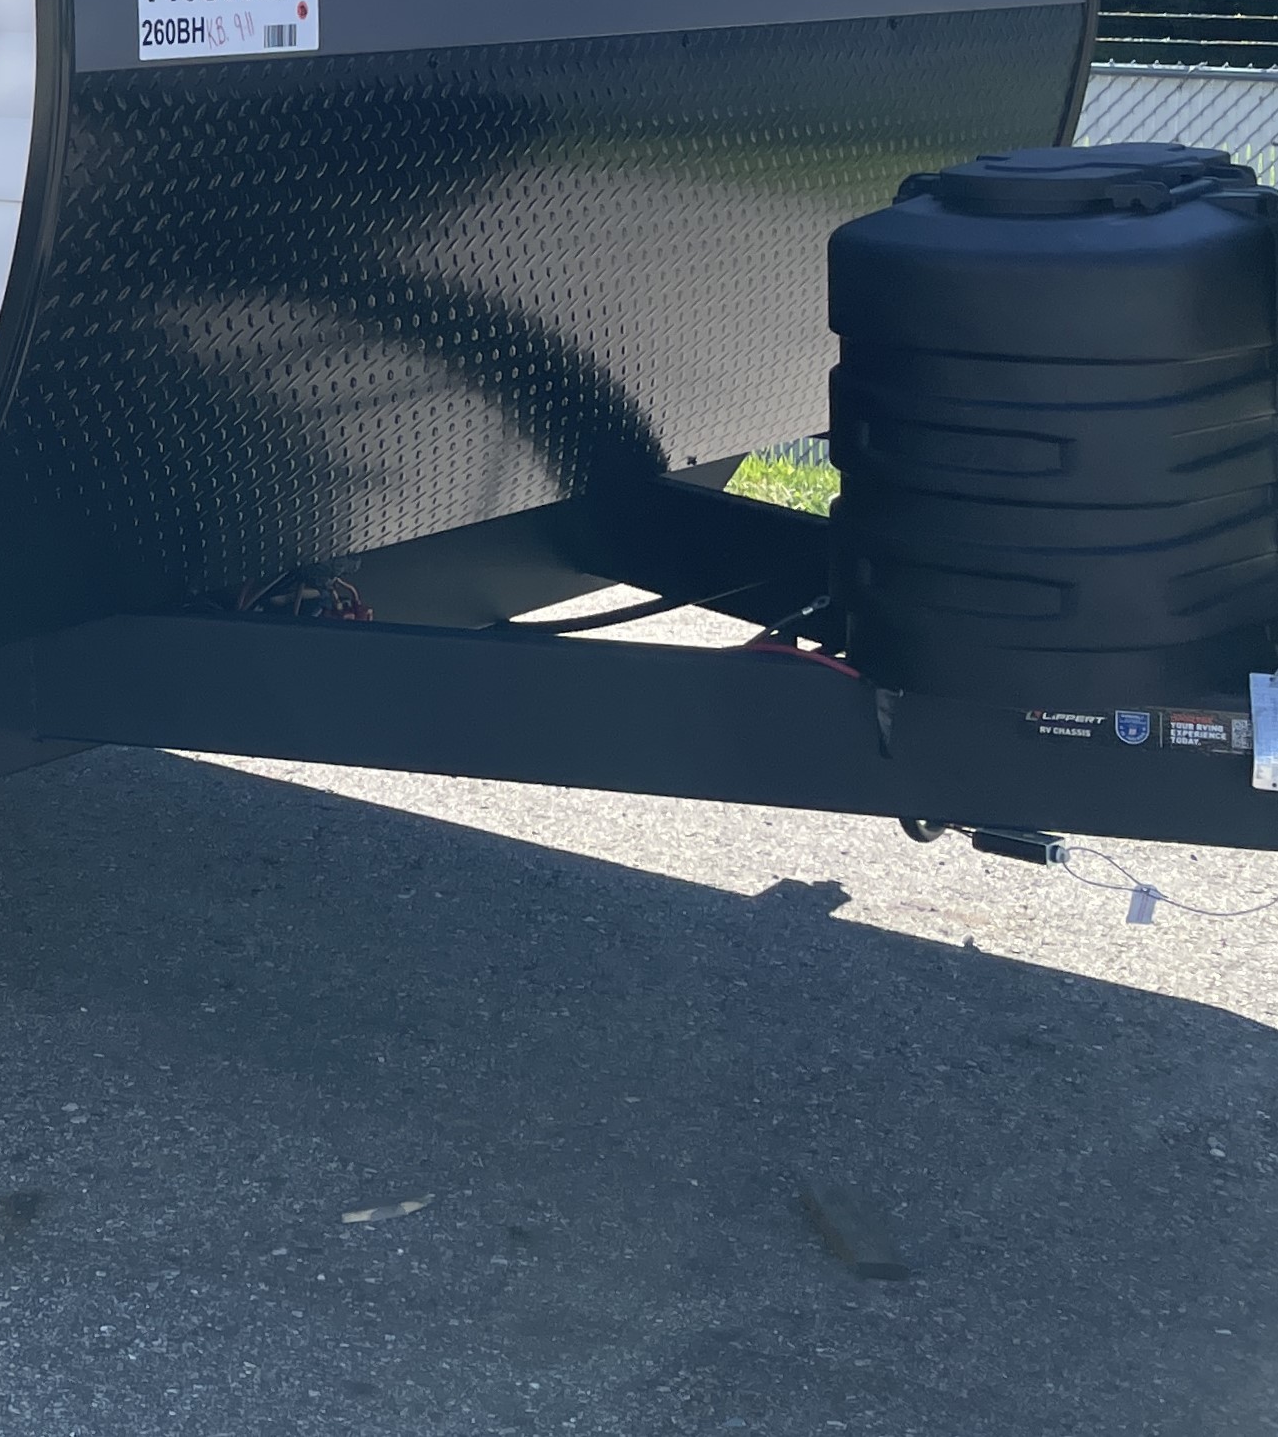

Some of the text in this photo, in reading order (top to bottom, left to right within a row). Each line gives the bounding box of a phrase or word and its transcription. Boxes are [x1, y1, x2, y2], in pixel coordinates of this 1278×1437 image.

[142, 16, 205, 46] 260BH
[1039, 725, 1092, 738] RV CHASSIS
[1170, 721, 1195, 731] YOUR
[1170, 729, 1227, 741] EXPERIENCE
